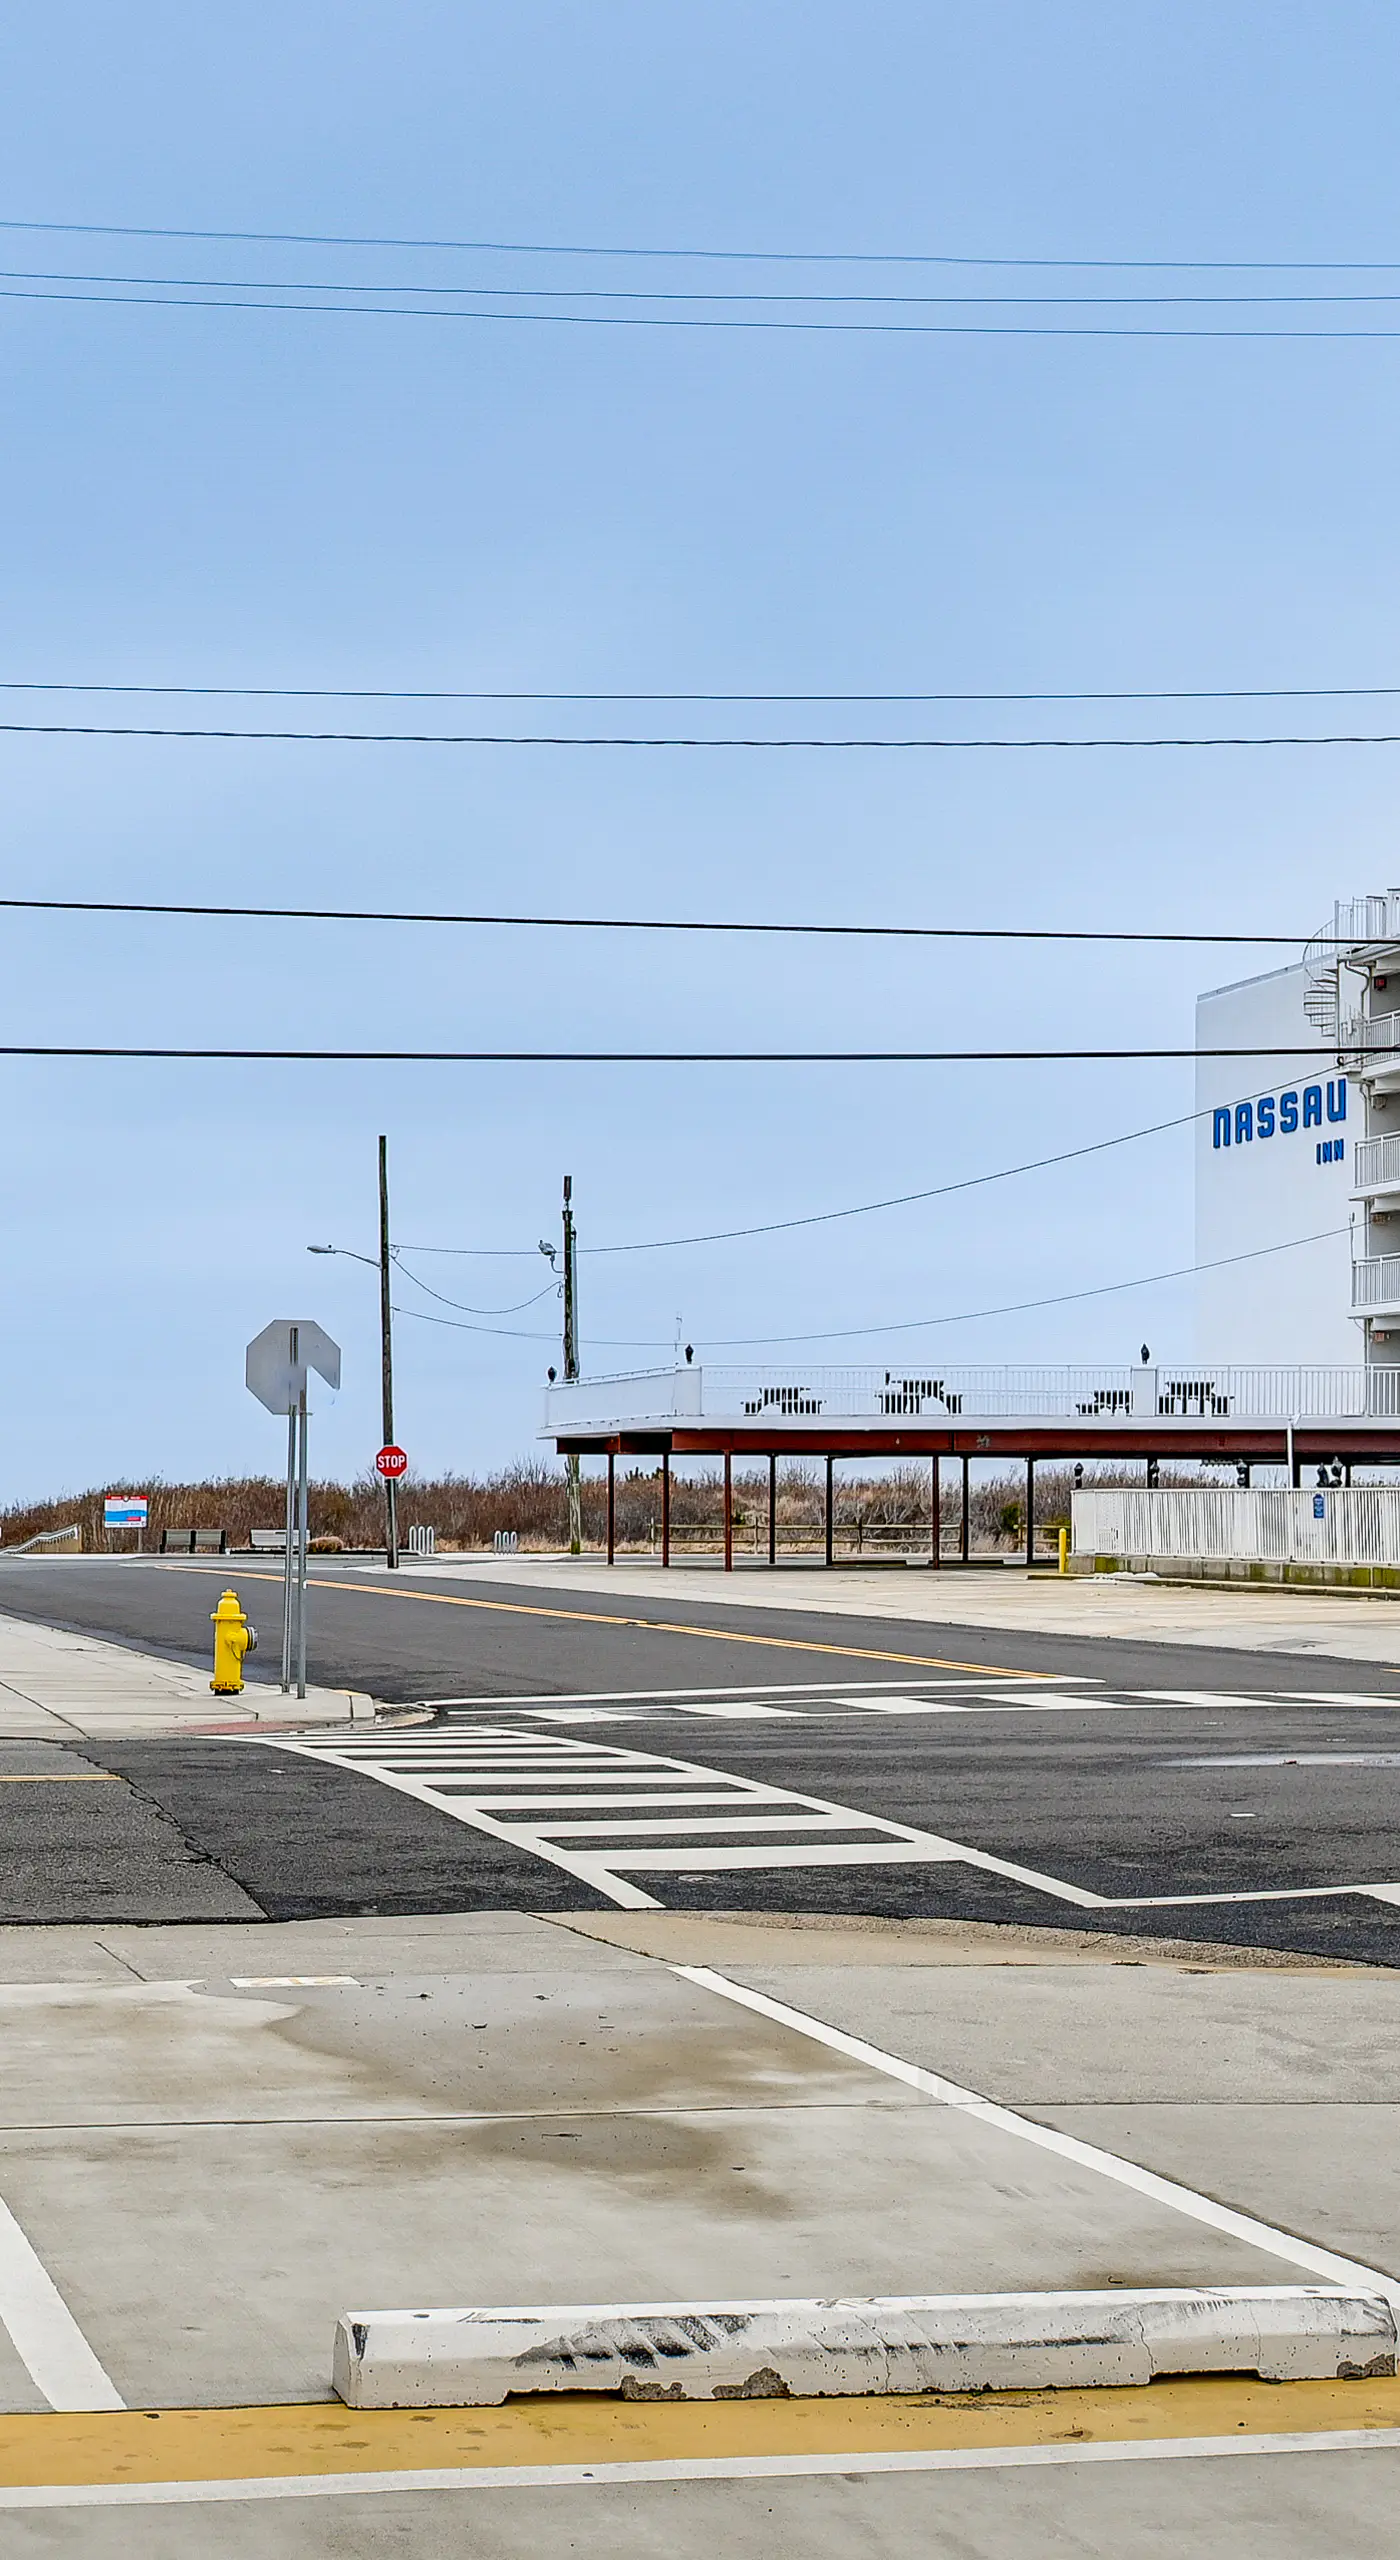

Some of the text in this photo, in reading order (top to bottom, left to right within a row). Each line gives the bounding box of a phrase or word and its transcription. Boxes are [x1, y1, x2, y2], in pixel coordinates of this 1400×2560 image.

[1213, 1078, 1346, 1149] NASSAU
[1316, 1138, 1344, 1165] INN
[377, 1455, 405, 1468] STOP
